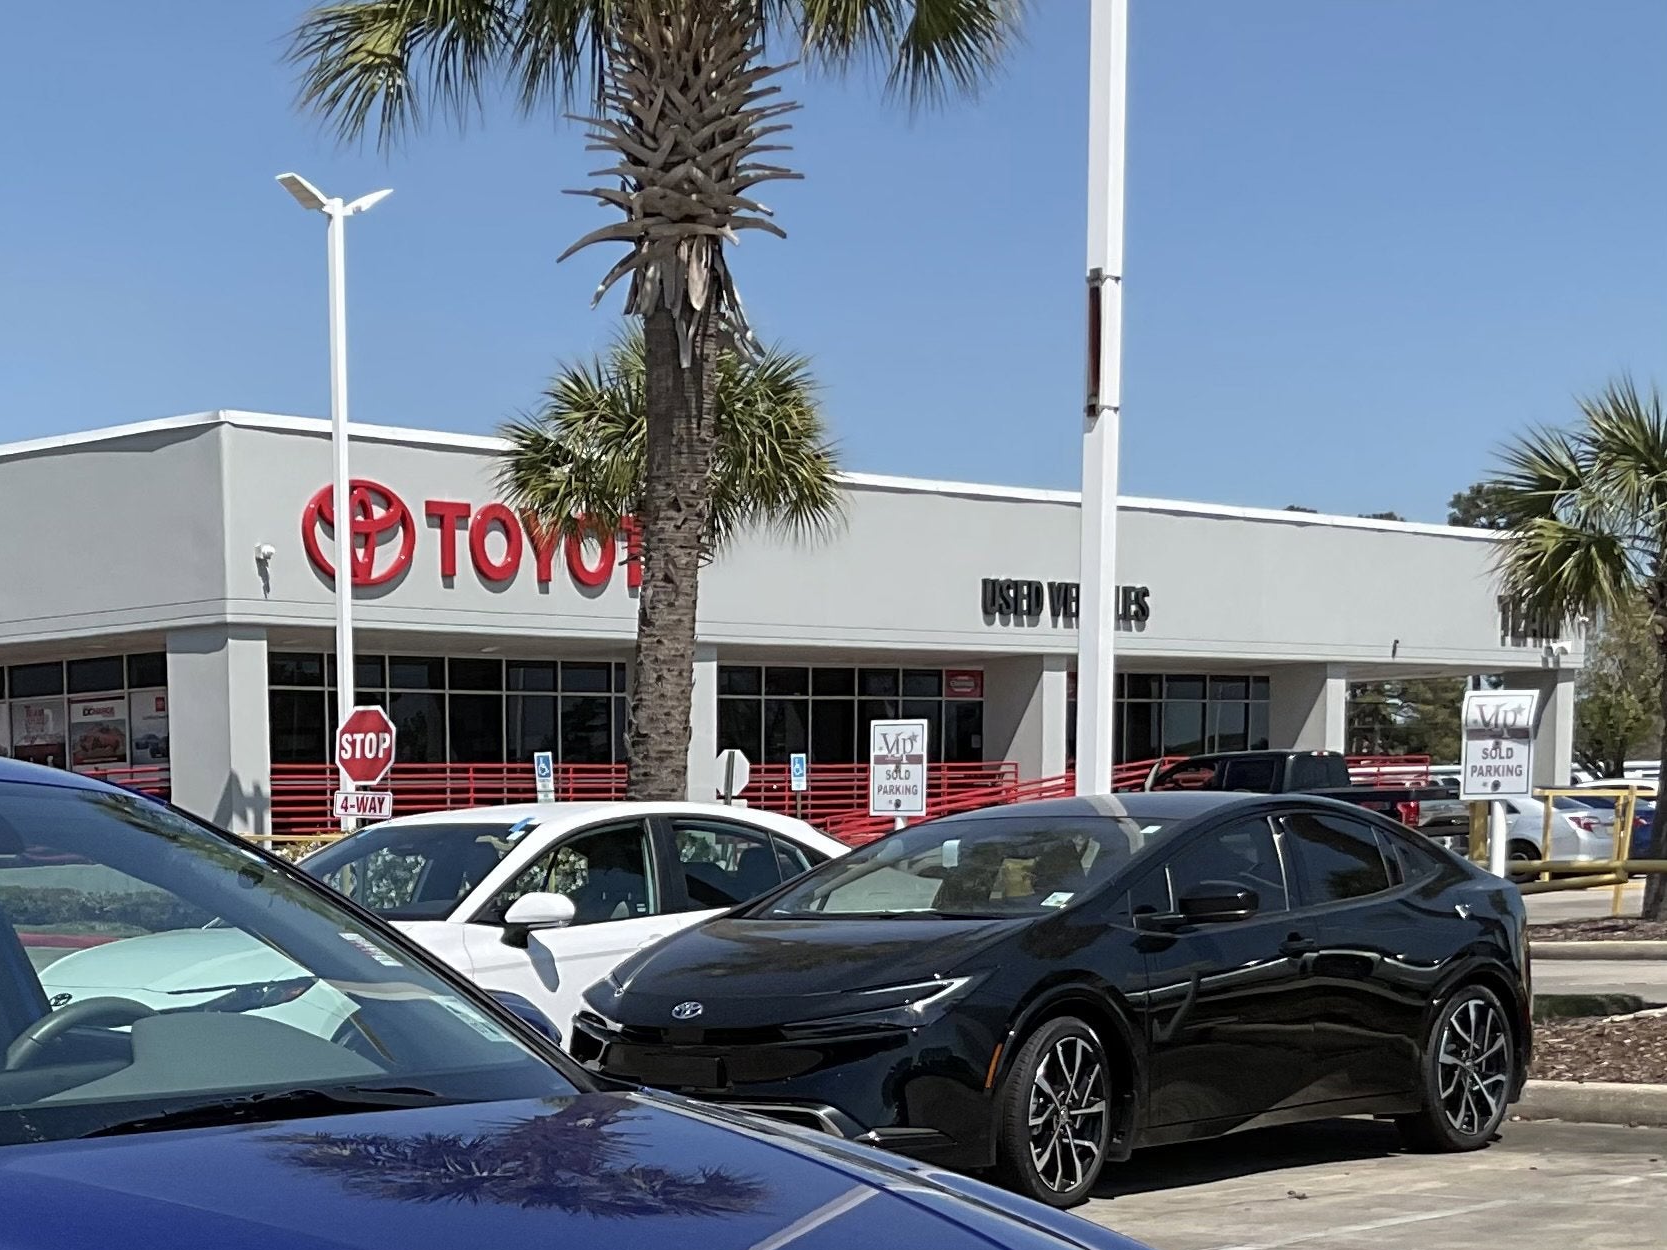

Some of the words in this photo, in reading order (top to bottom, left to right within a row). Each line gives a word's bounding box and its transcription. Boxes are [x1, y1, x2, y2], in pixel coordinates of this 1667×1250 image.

[425, 500, 643, 588] TOYOT
[981, 578, 1044, 616] USED
[1047, 582, 1150, 622] VELES
[341, 732, 390, 759] STOP
[1482, 748, 1514, 760] SOLD
[886, 770, 911, 780] SOLD
[1471, 765, 1523, 777] PARKING
[877, 785, 918, 795] PARKING
[340, 796, 385, 813] 4-WAY
